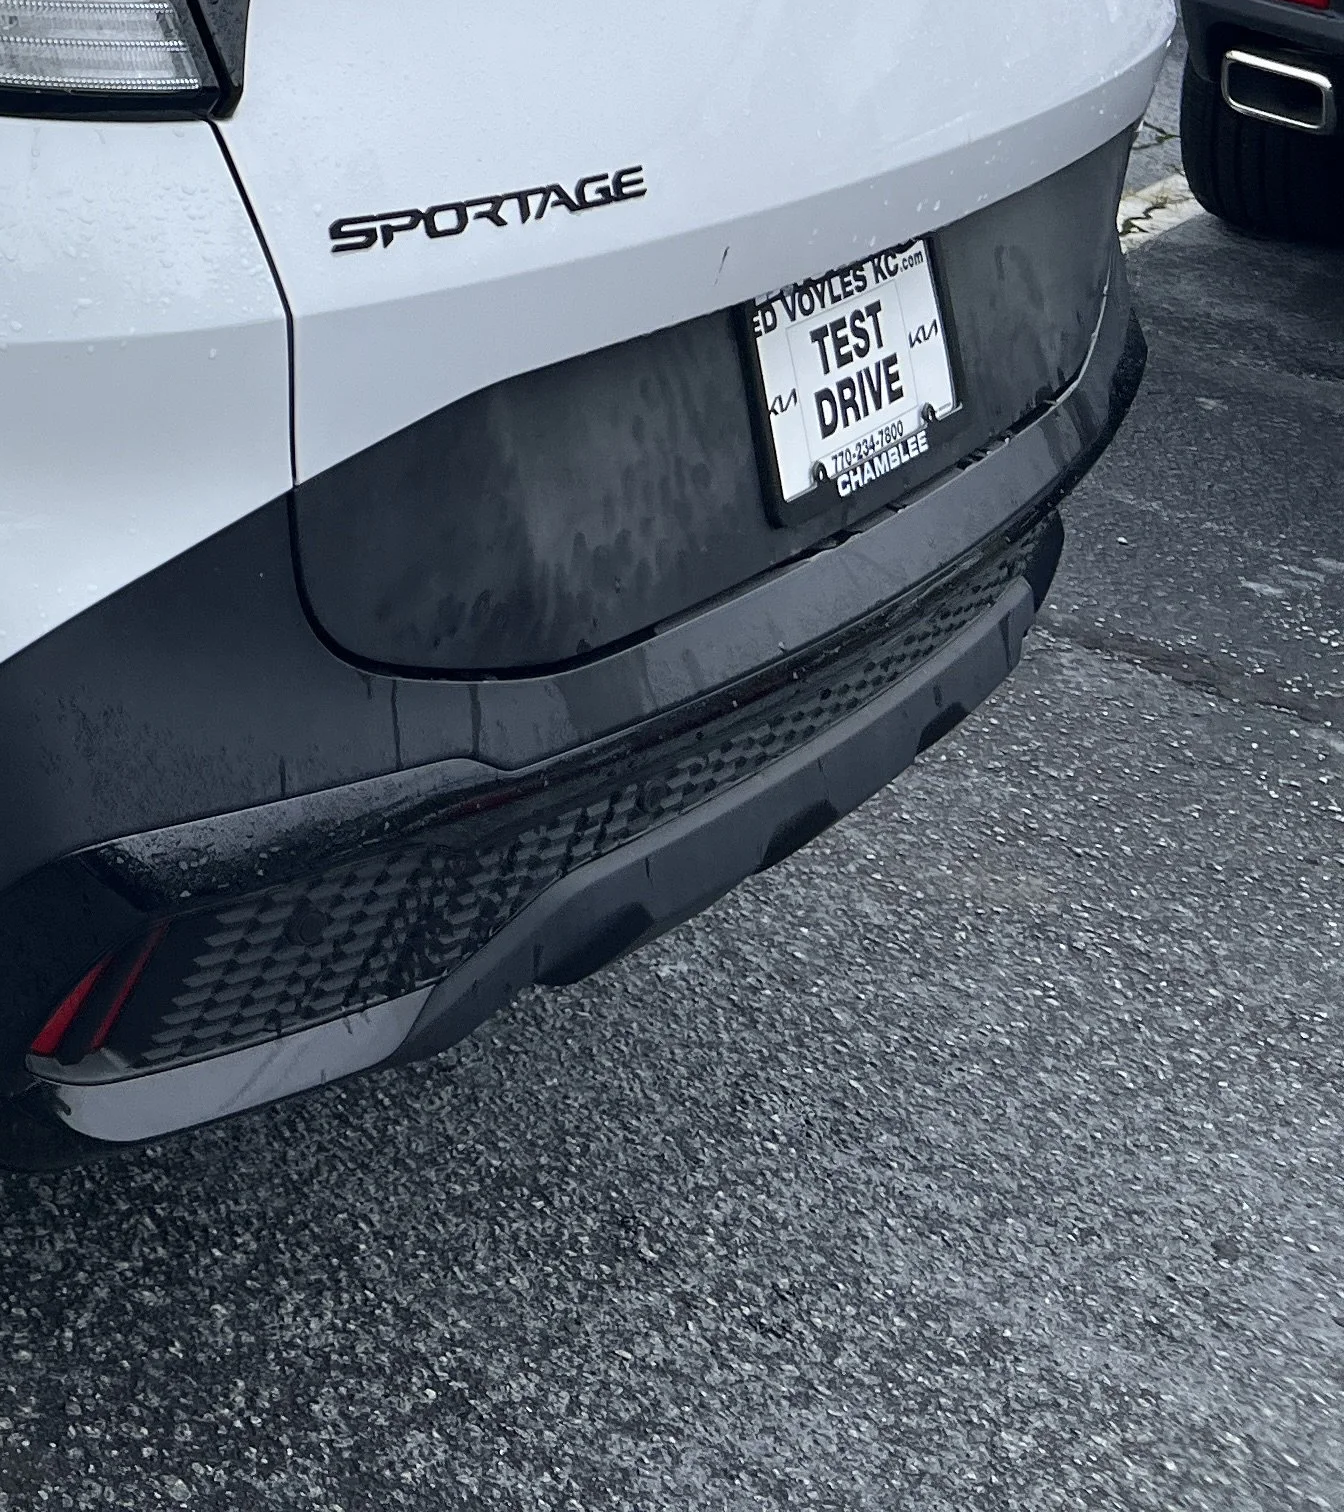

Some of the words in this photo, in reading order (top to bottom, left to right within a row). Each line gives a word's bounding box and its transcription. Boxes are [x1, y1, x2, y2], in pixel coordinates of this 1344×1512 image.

[329, 165, 648, 253] SPORTAGE
[780, 267, 868, 322] VOYLES
[809, 299, 884, 375] TEST
[814, 352, 905, 440] DRIVE
[831, 419, 904, 474] 770-234-7800
[836, 430, 929, 498] CHAMBLEE
